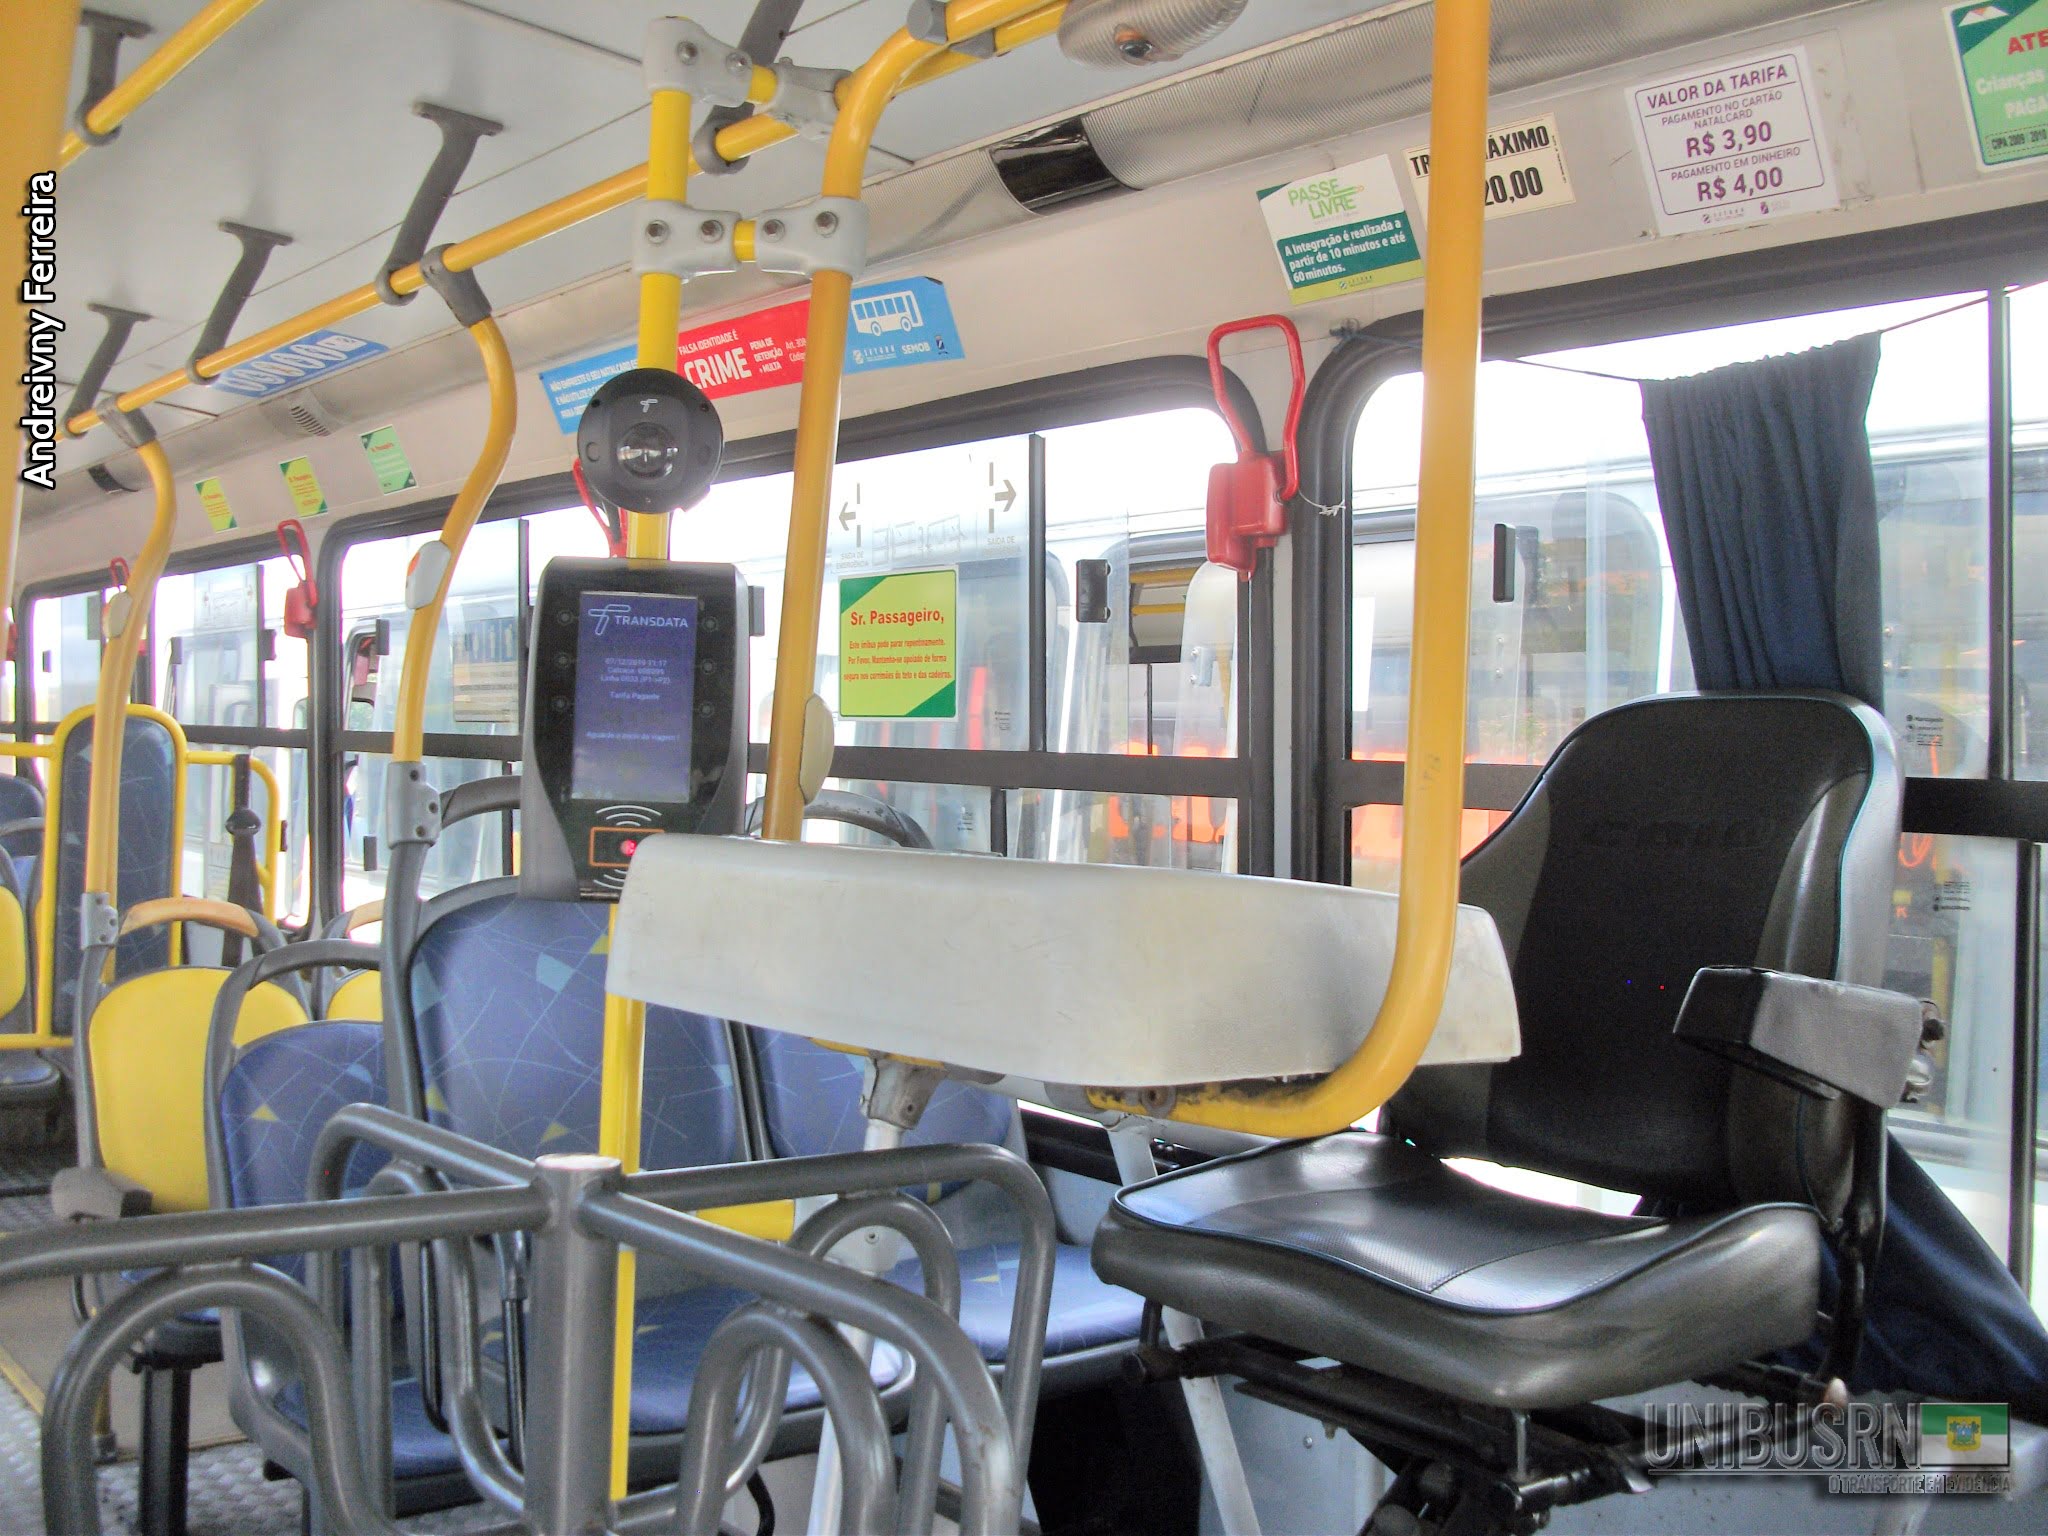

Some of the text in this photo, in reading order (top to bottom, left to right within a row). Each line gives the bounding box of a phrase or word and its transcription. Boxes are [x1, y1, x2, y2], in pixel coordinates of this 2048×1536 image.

[1647, 64, 1788, 109] VALOR DA TARIFA
[1661, 90, 1783, 126] PAGAMENTO NO CARTÃO
[1694, 109, 1753, 130] NATALCARD
[1686, 121, 1772, 158] R$ 3,90
[1671, 146, 1800, 181] PAGAMENTO EM DINHEIRO
[1288, 178, 1340, 207] PASSE
[1697, 166, 1783, 202] R$ 4,00
[1309, 197, 1357, 220] LIVRE
[1284, 220, 1401, 257] A Integração é realizada a
[1289, 231, 1406, 272] partir de 10 minutos e até
[1293, 263, 1346, 283] 60 minutos.
[678, 328, 739, 356] FALSA IDENTIDADE É
[749, 337, 774, 350] PENA DE
[753, 347, 783, 363] DETENÇÃO
[901, 341, 931, 355] SEMOB
[683, 347, 752, 390] CRIME
[762, 360, 783, 374] MULTA
[614, 614, 689, 628] TRANSDATA
[850, 607, 945, 627] Sr. Passageiro,
